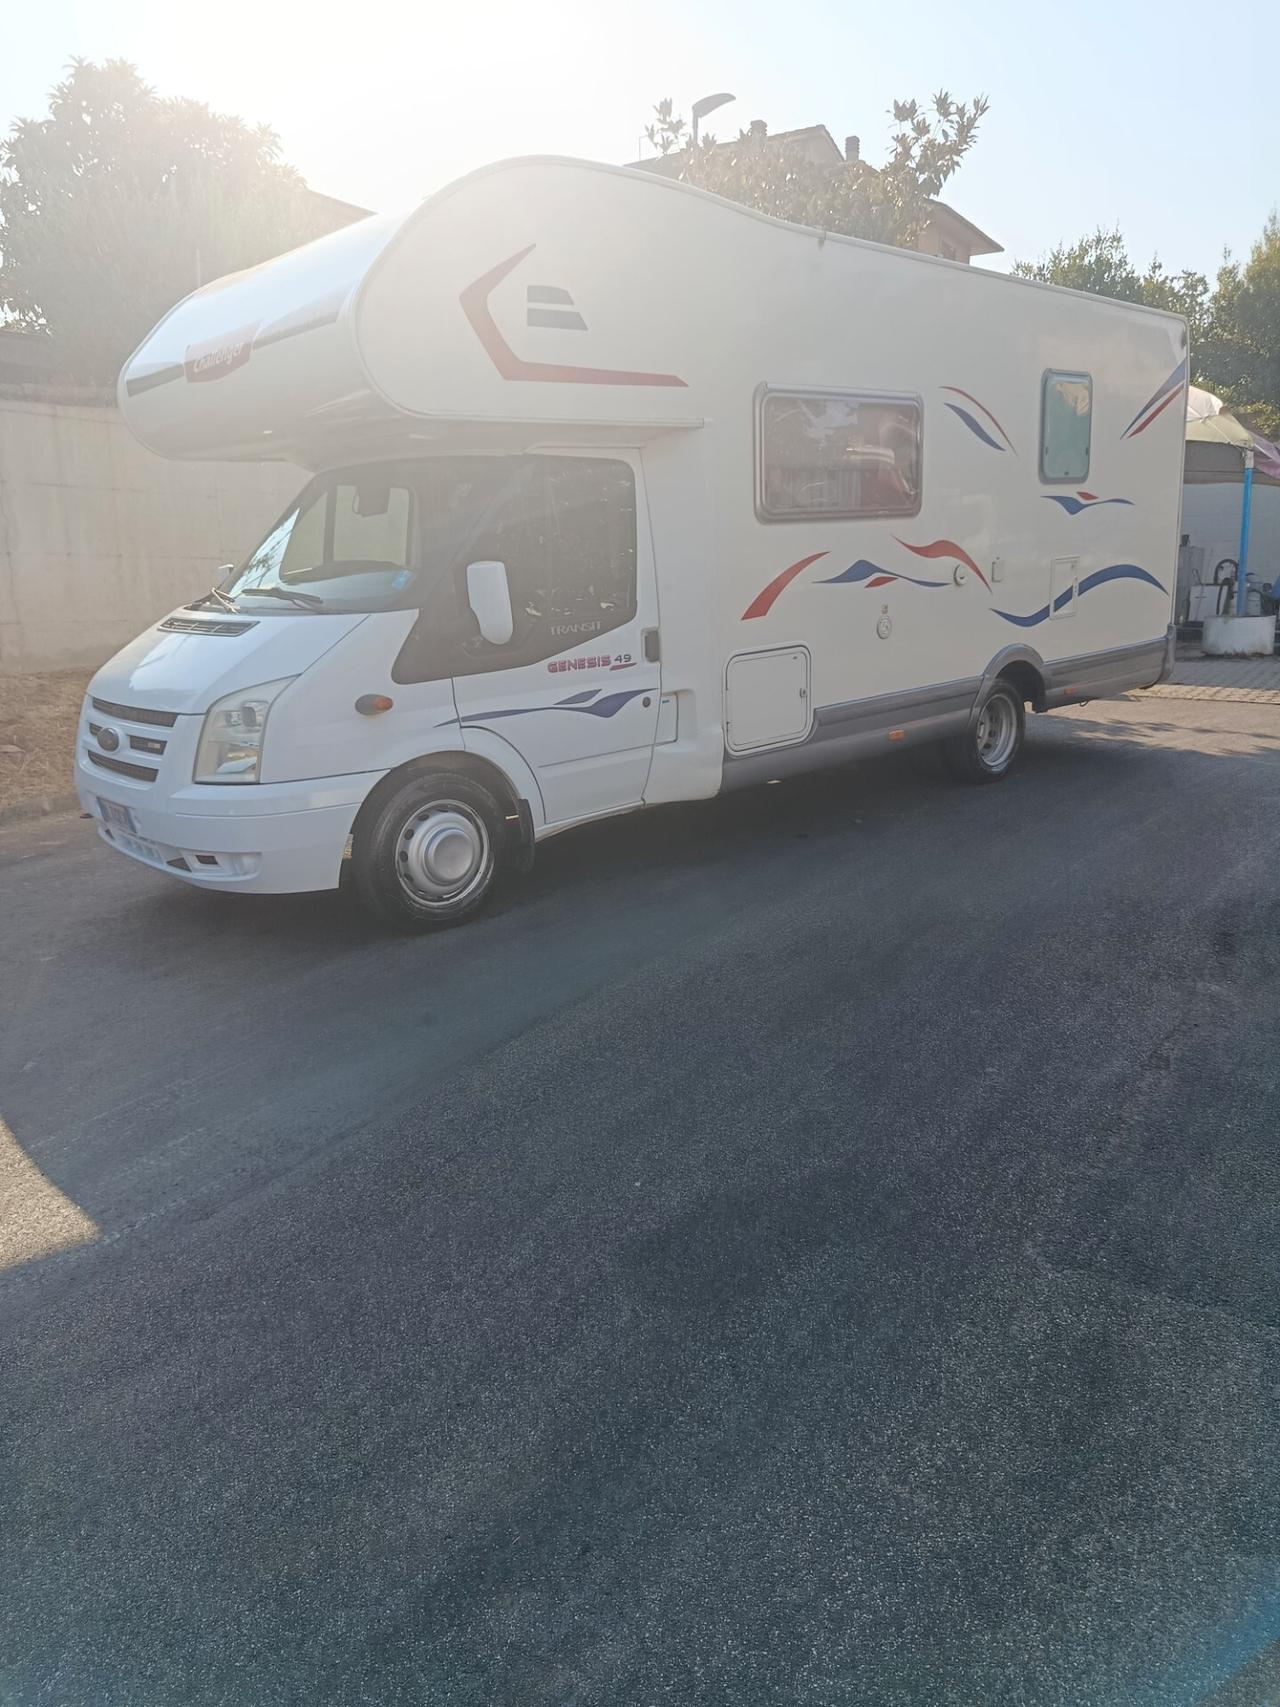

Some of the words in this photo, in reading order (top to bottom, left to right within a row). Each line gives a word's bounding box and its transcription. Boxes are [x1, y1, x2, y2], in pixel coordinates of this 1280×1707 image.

[193, 341, 245, 373] Challenger
[549, 620, 603, 635] TRANSIT
[547, 654, 610, 673] GENESIS
[614, 654, 632, 663] 49
